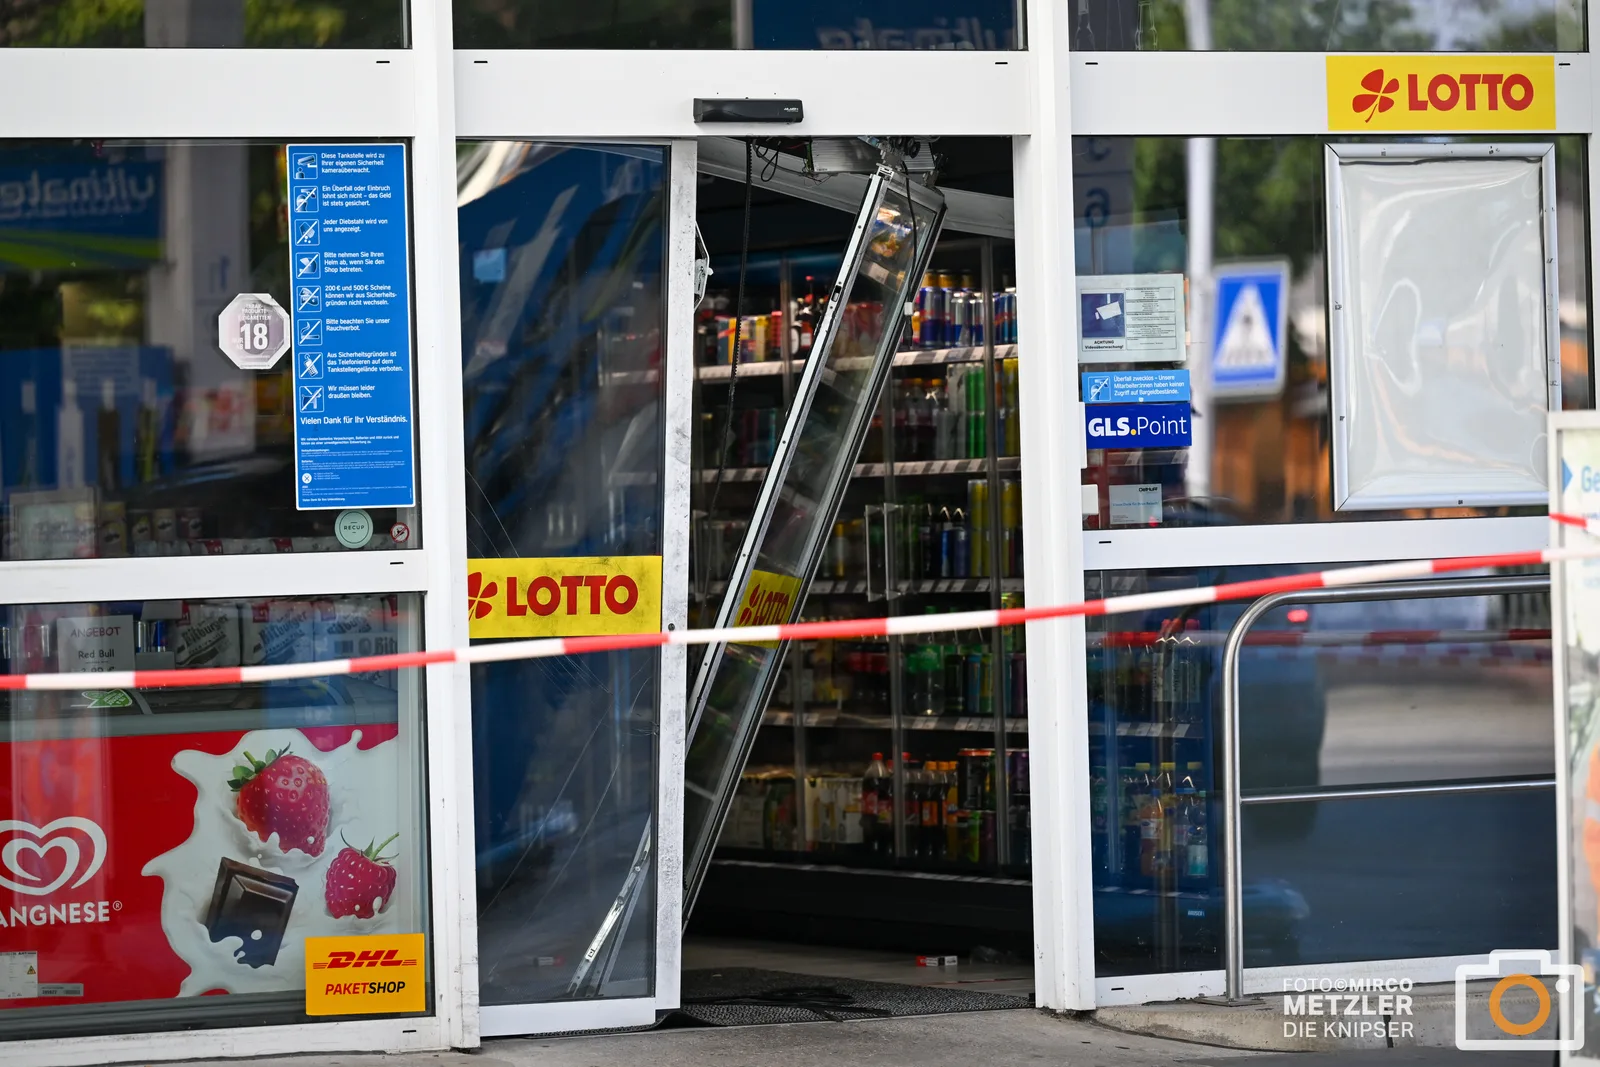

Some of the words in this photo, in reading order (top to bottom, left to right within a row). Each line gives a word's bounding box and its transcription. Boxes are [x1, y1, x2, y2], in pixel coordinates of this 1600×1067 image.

[1408, 73, 1534, 112] LOTTO
[241, 323, 268, 350] 18
[1088, 416, 1188, 437] GLS.Point
[506, 574, 638, 617] LOTTO
[755, 590, 790, 627] LOTTO
[70, 627, 121, 637] ANGEBOT
[182, 614, 228, 646] Bitburger
[99, 649, 114, 657] Bull
[327, 949, 403, 969] DHL
[325, 980, 406, 996] PAKETSHOP
